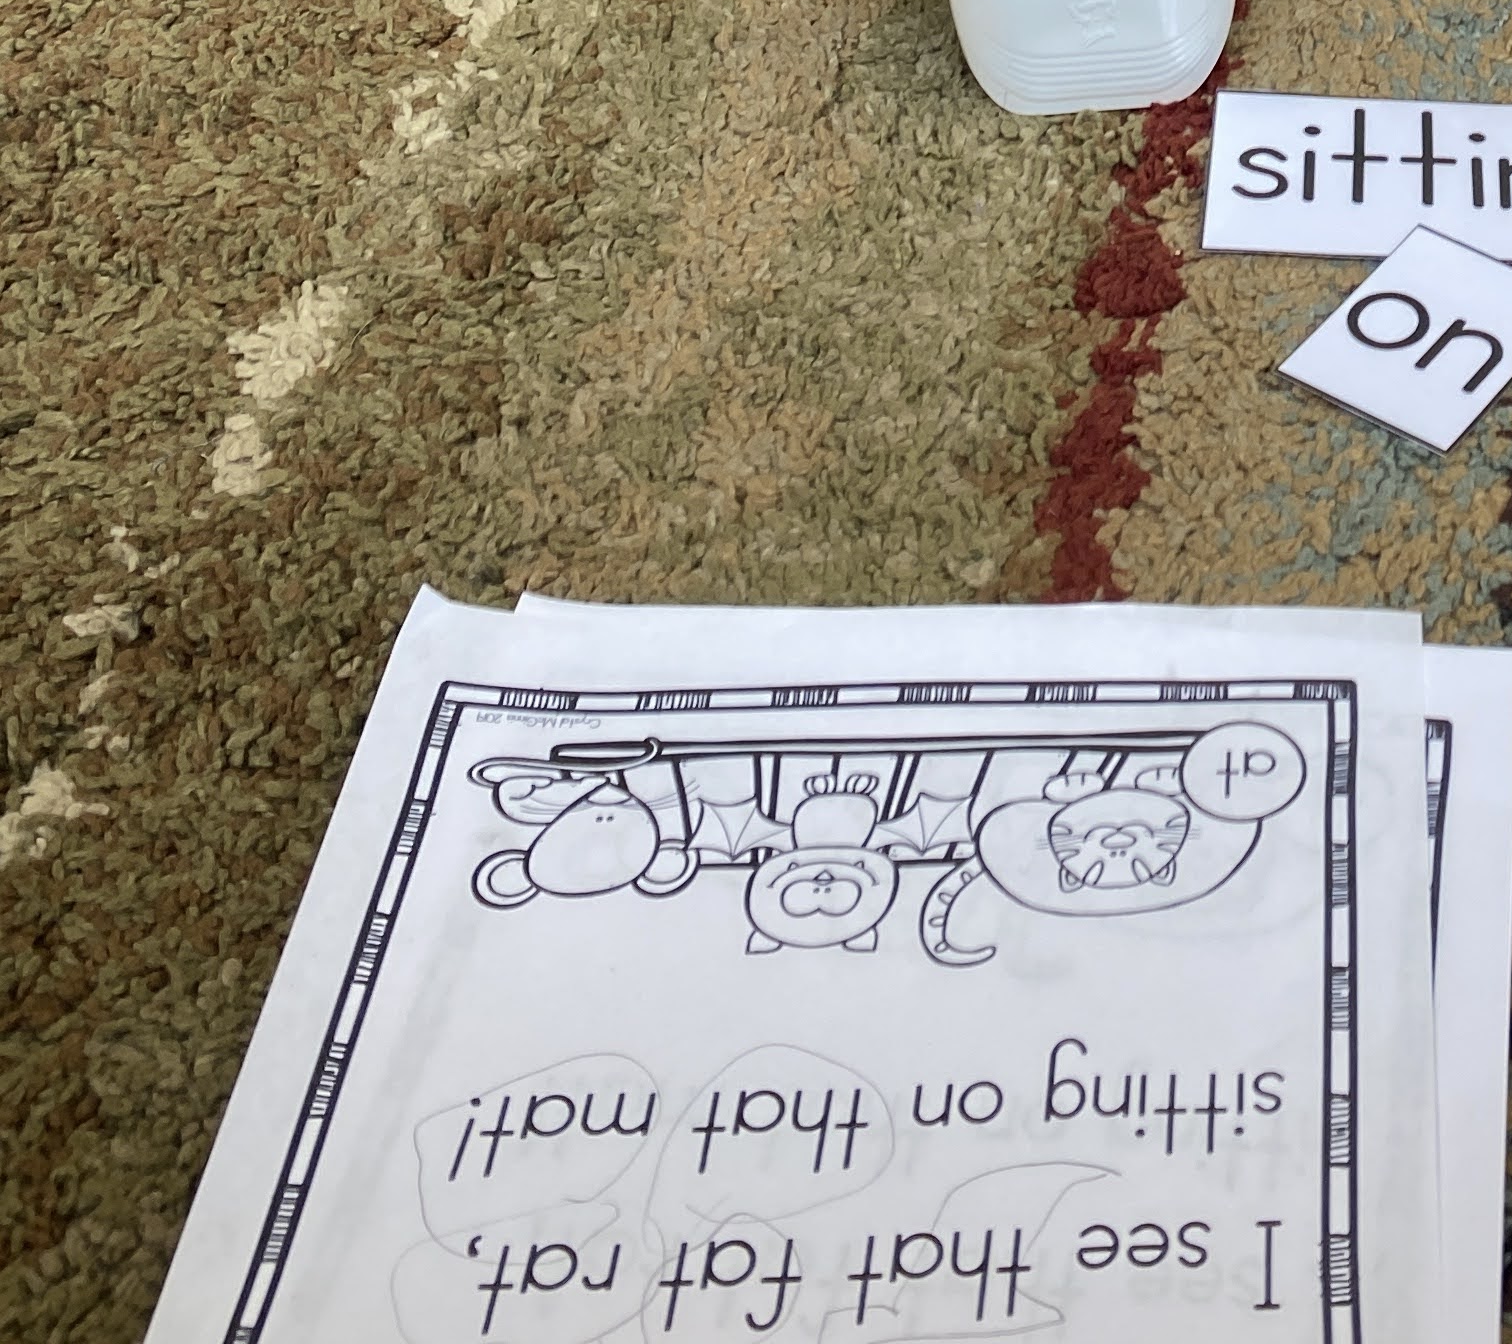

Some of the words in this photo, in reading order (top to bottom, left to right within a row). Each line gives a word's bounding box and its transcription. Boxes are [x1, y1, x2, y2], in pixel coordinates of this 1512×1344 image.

[1346, 291, 1505, 394] on
[1215, 749, 1278, 800] at
[447, 1093, 656, 1183] mat!
[692, 1088, 869, 1175] that
[911, 1079, 1004, 1131] on
[1043, 1037, 1286, 1155] sitting
[466, 1235, 617, 1337] rat,
[658, 1239, 801, 1332] fat
[848, 1227, 1031, 1326] that
[1075, 1221, 1211, 1272] see
[1252, 1220, 1284, 1312] I
